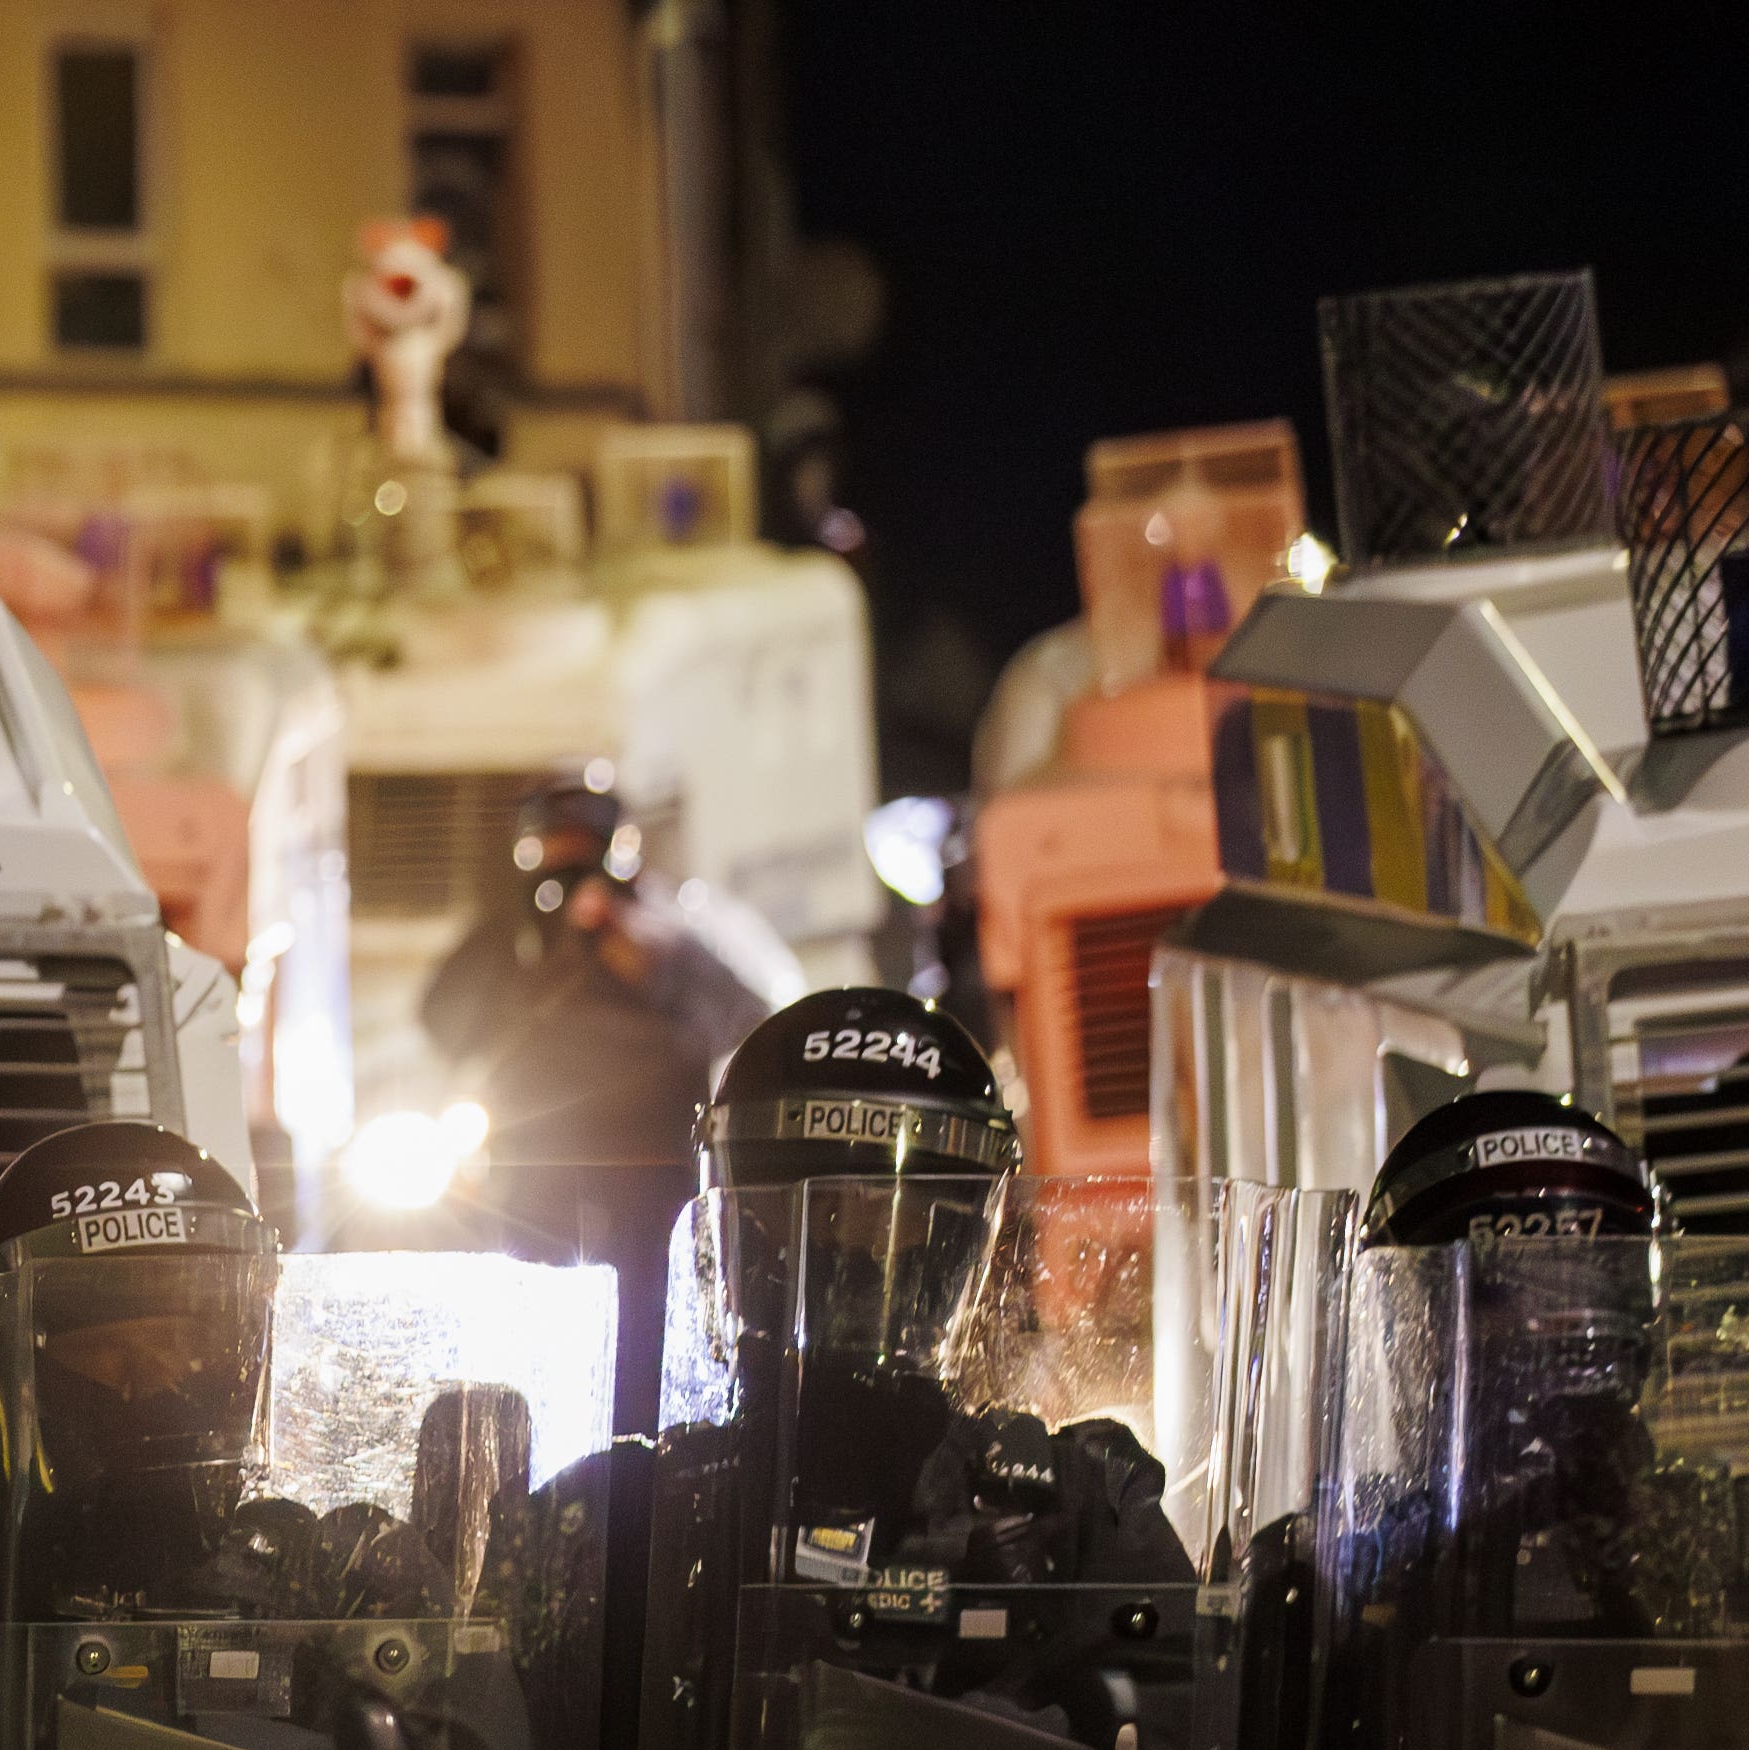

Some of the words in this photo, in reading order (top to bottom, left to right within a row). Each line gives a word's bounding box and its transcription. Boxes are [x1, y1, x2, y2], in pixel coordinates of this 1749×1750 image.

[803, 1029, 942, 1080] 52244
[809, 1105, 903, 1138] POLICE
[1483, 1132, 1578, 1162] POLICE
[85, 1211, 182, 1248] POLICE
